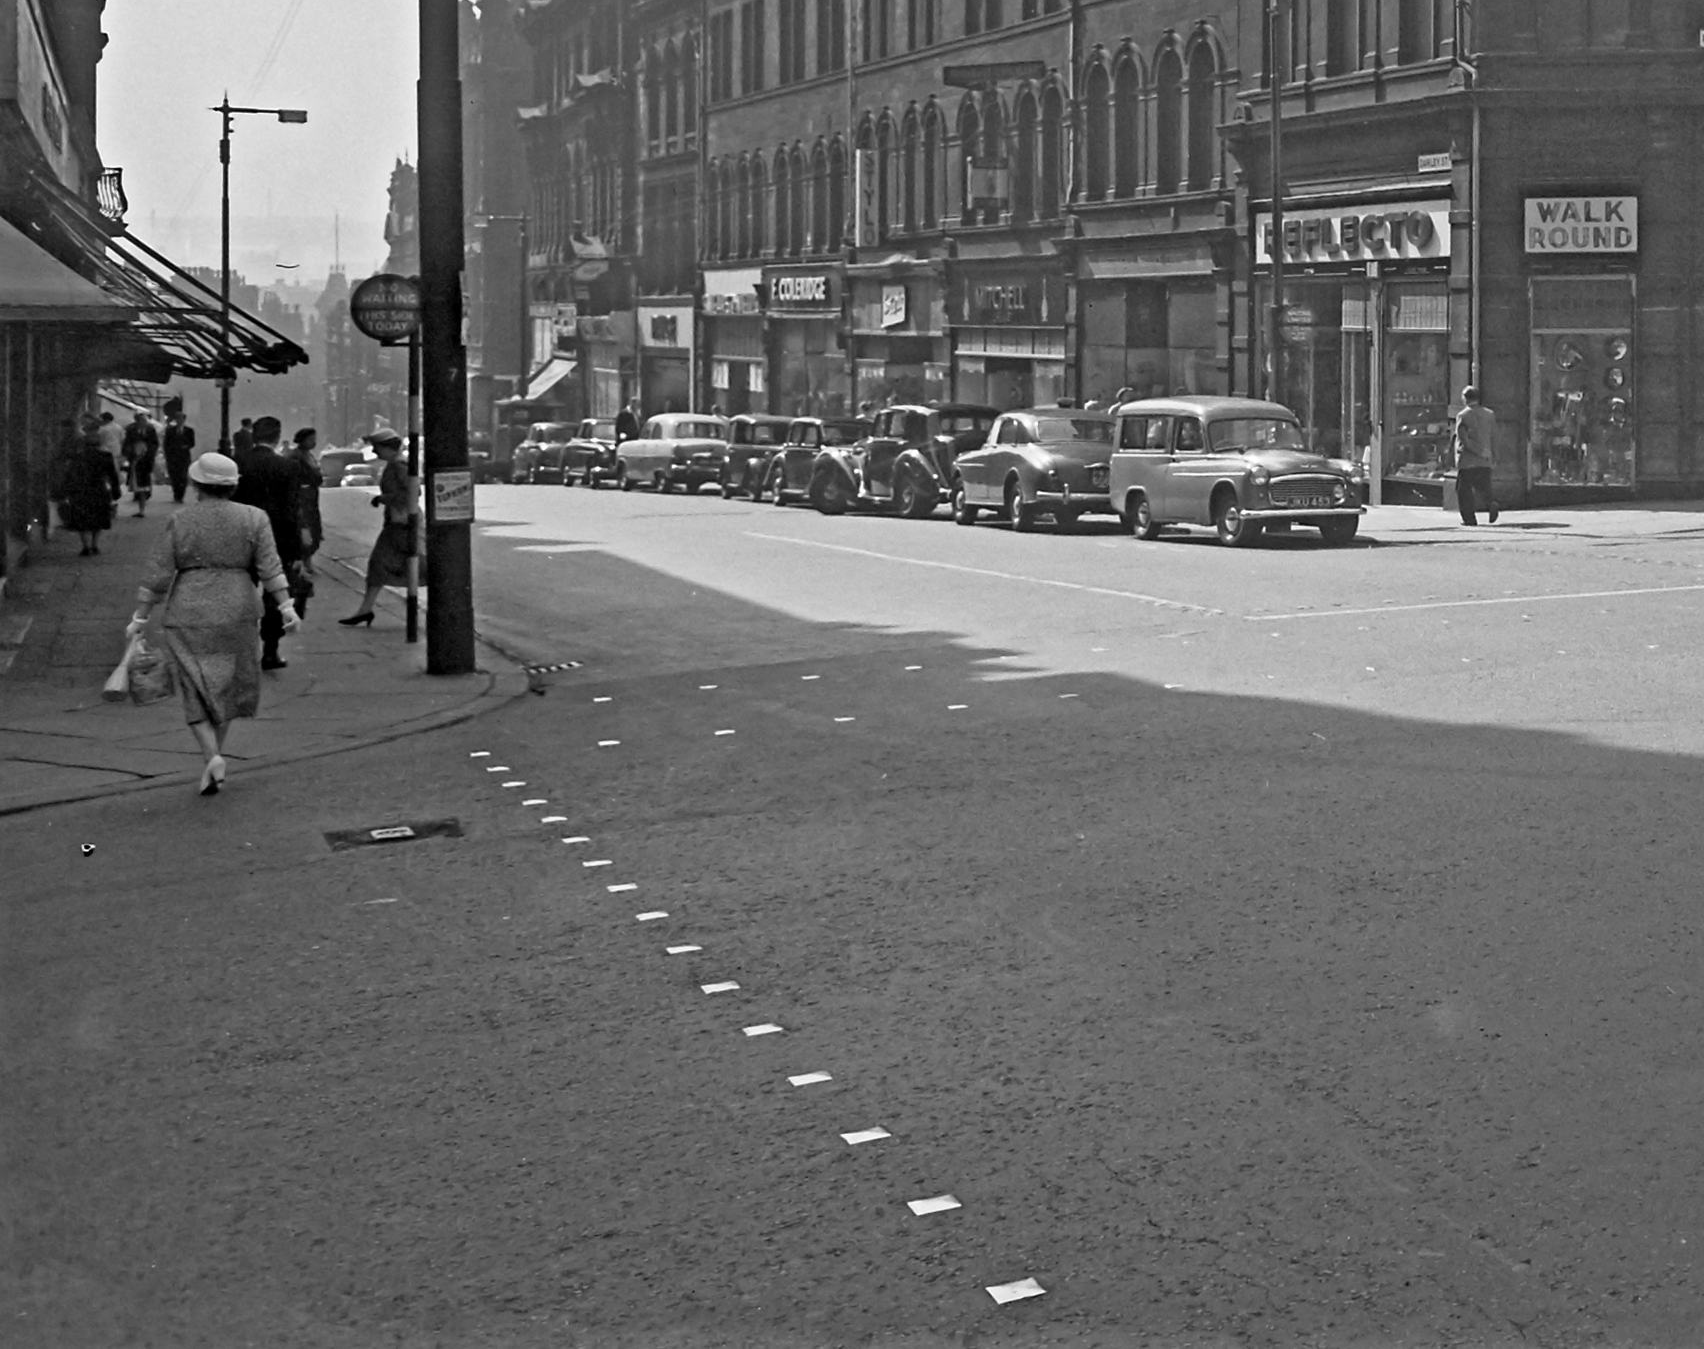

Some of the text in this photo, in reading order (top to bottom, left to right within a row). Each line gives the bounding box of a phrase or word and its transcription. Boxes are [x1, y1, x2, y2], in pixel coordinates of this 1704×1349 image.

[863, 155, 876, 245] STYLO
[1536, 200, 1624, 223] WALK
[1528, 226, 1632, 249] ROUND
[362, 293, 417, 303] WAITING
[367, 321, 408, 330] TODAY
